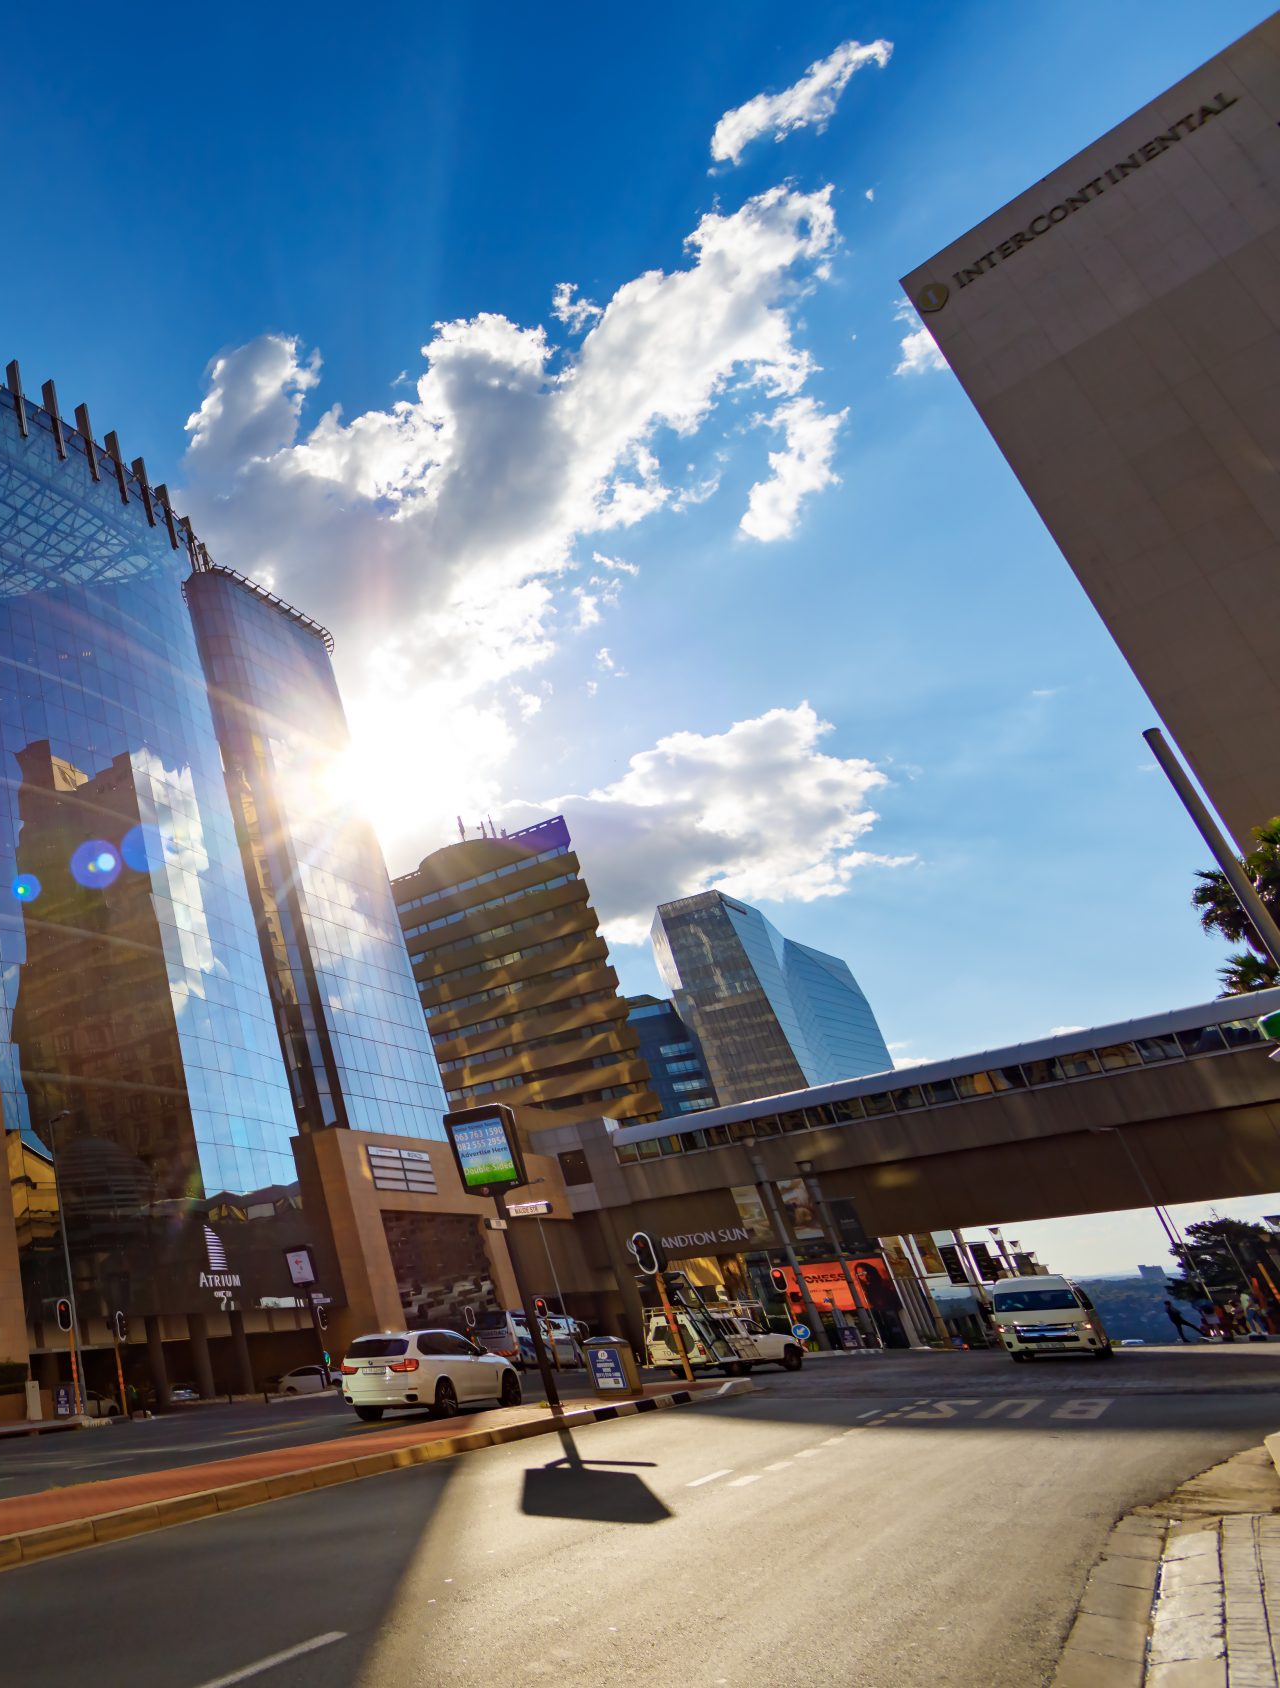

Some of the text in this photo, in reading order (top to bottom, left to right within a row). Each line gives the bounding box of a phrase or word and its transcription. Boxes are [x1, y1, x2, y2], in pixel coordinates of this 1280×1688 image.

[952, 92, 1238, 288] INTERCONTINENTAL
[485, 1126, 503, 1136] 1590
[461, 1146, 508, 1158] Advertise Here
[464, 1161, 513, 1175] Double Sided
[661, 1227, 749, 1249] ANDTON SUN
[199, 1271, 241, 1287] ATRIUM
[792, 1272, 847, 1285] ONESS
[904, 1399, 1115, 1420] BUS
